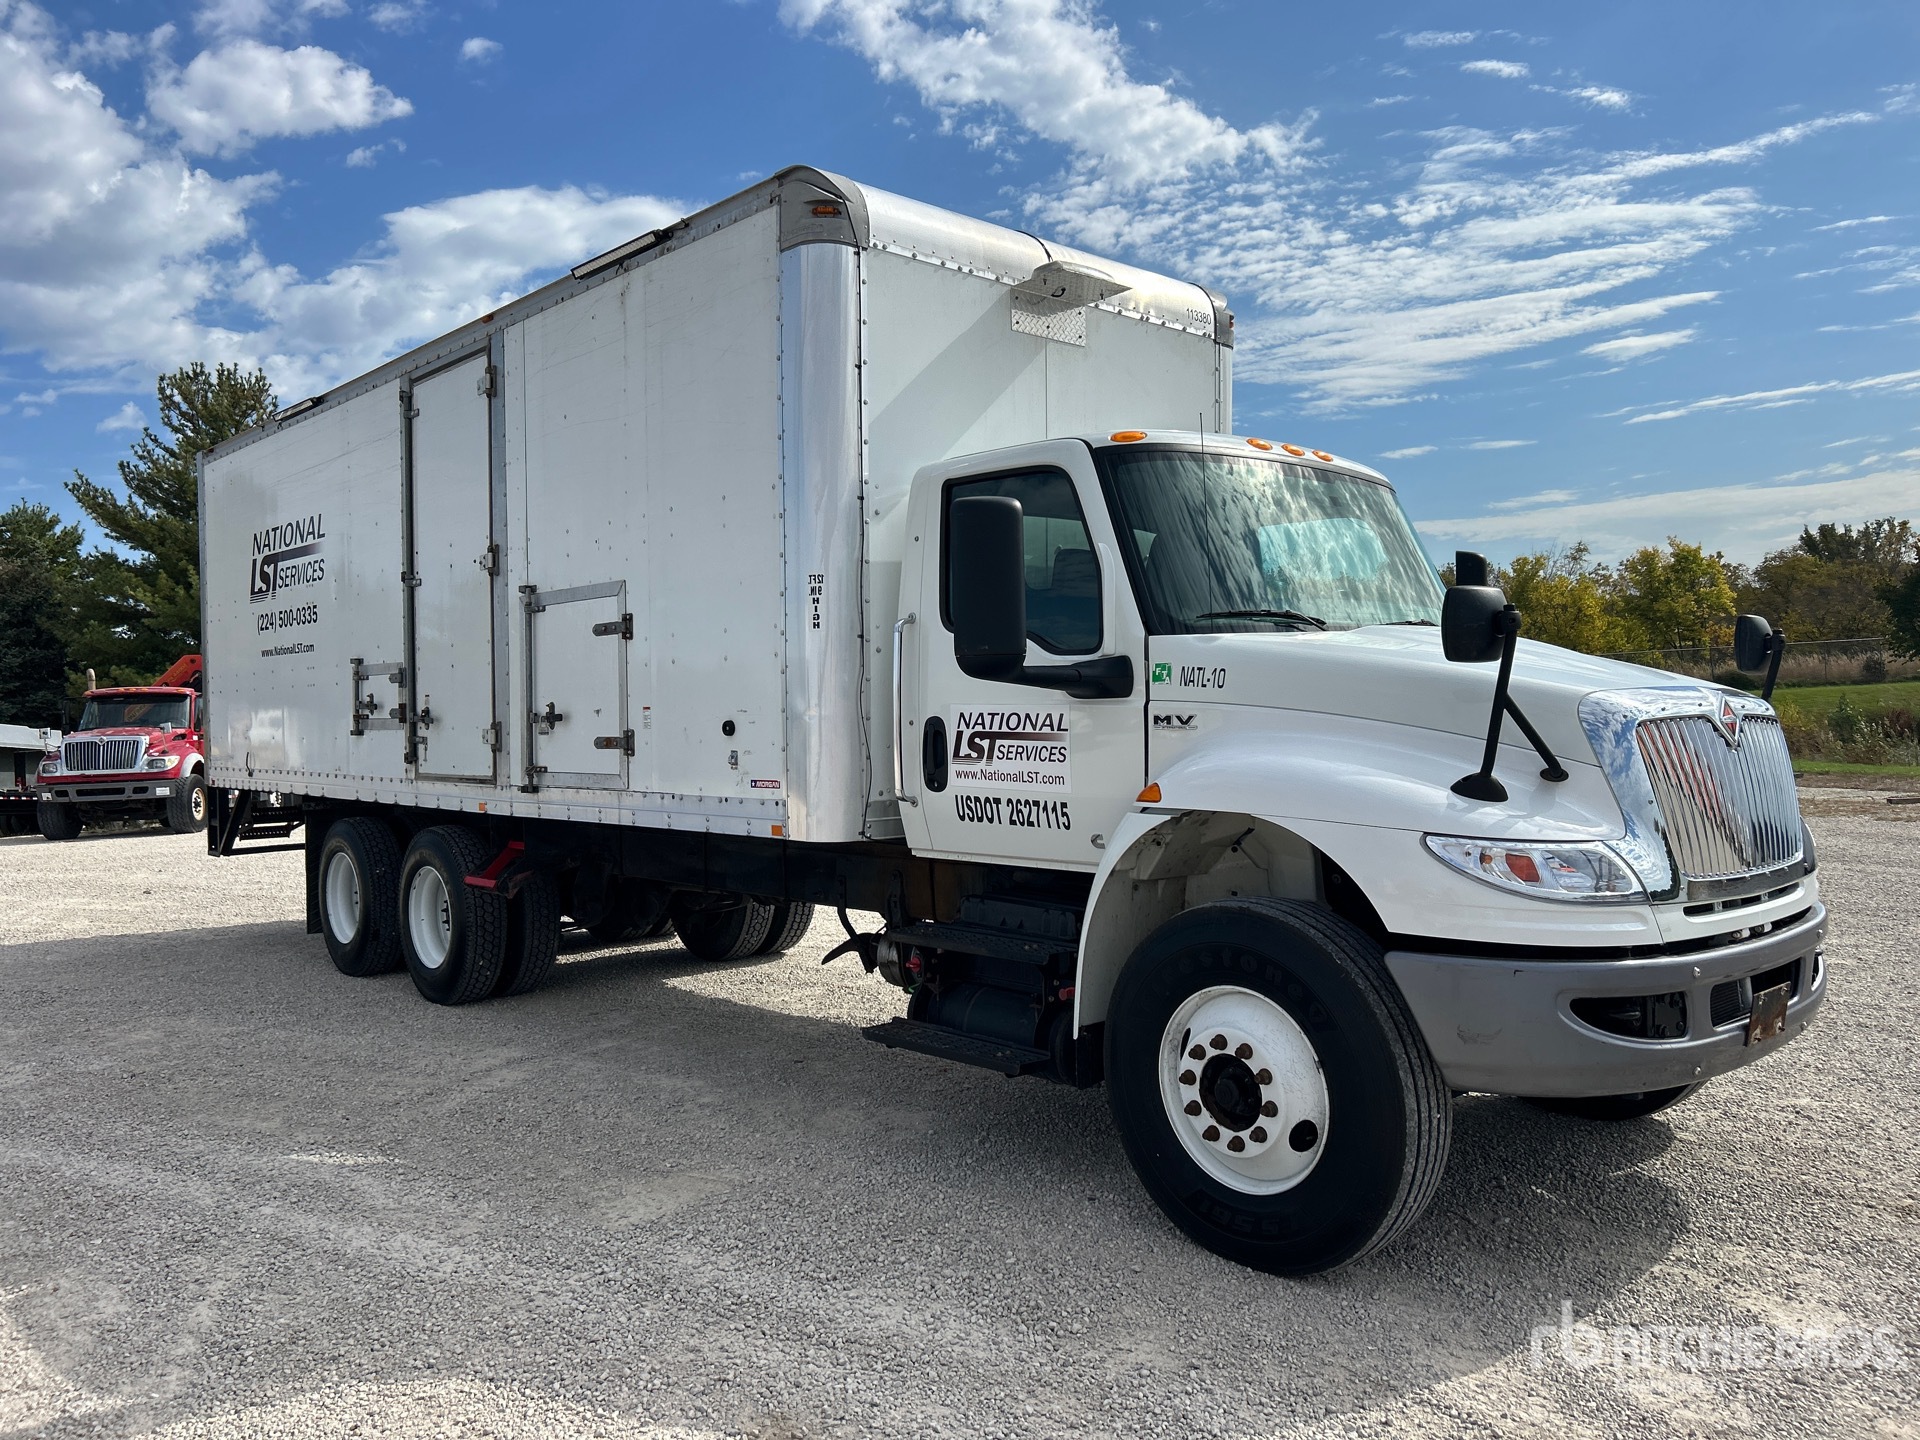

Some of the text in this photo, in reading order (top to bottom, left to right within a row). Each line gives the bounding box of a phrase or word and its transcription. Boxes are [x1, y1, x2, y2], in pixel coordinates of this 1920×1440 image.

[1186, 307, 1212, 325] 113380
[252, 513, 325, 556] NATIONAL
[250, 554, 325, 604] LST SERVICES
[257, 604, 318, 635] (224) 500-0335
[261, 643, 315, 658] www.NationalLST.com
[1179, 665, 1227, 689] NATL-10
[957, 711, 1069, 733] NATIONAL
[1153, 714, 1196, 726] MV
[951, 730, 1067, 767] LST SERVICES
[955, 768, 1066, 786] www.NationalLST.com
[954, 794, 1072, 831] USDOT 2627115
